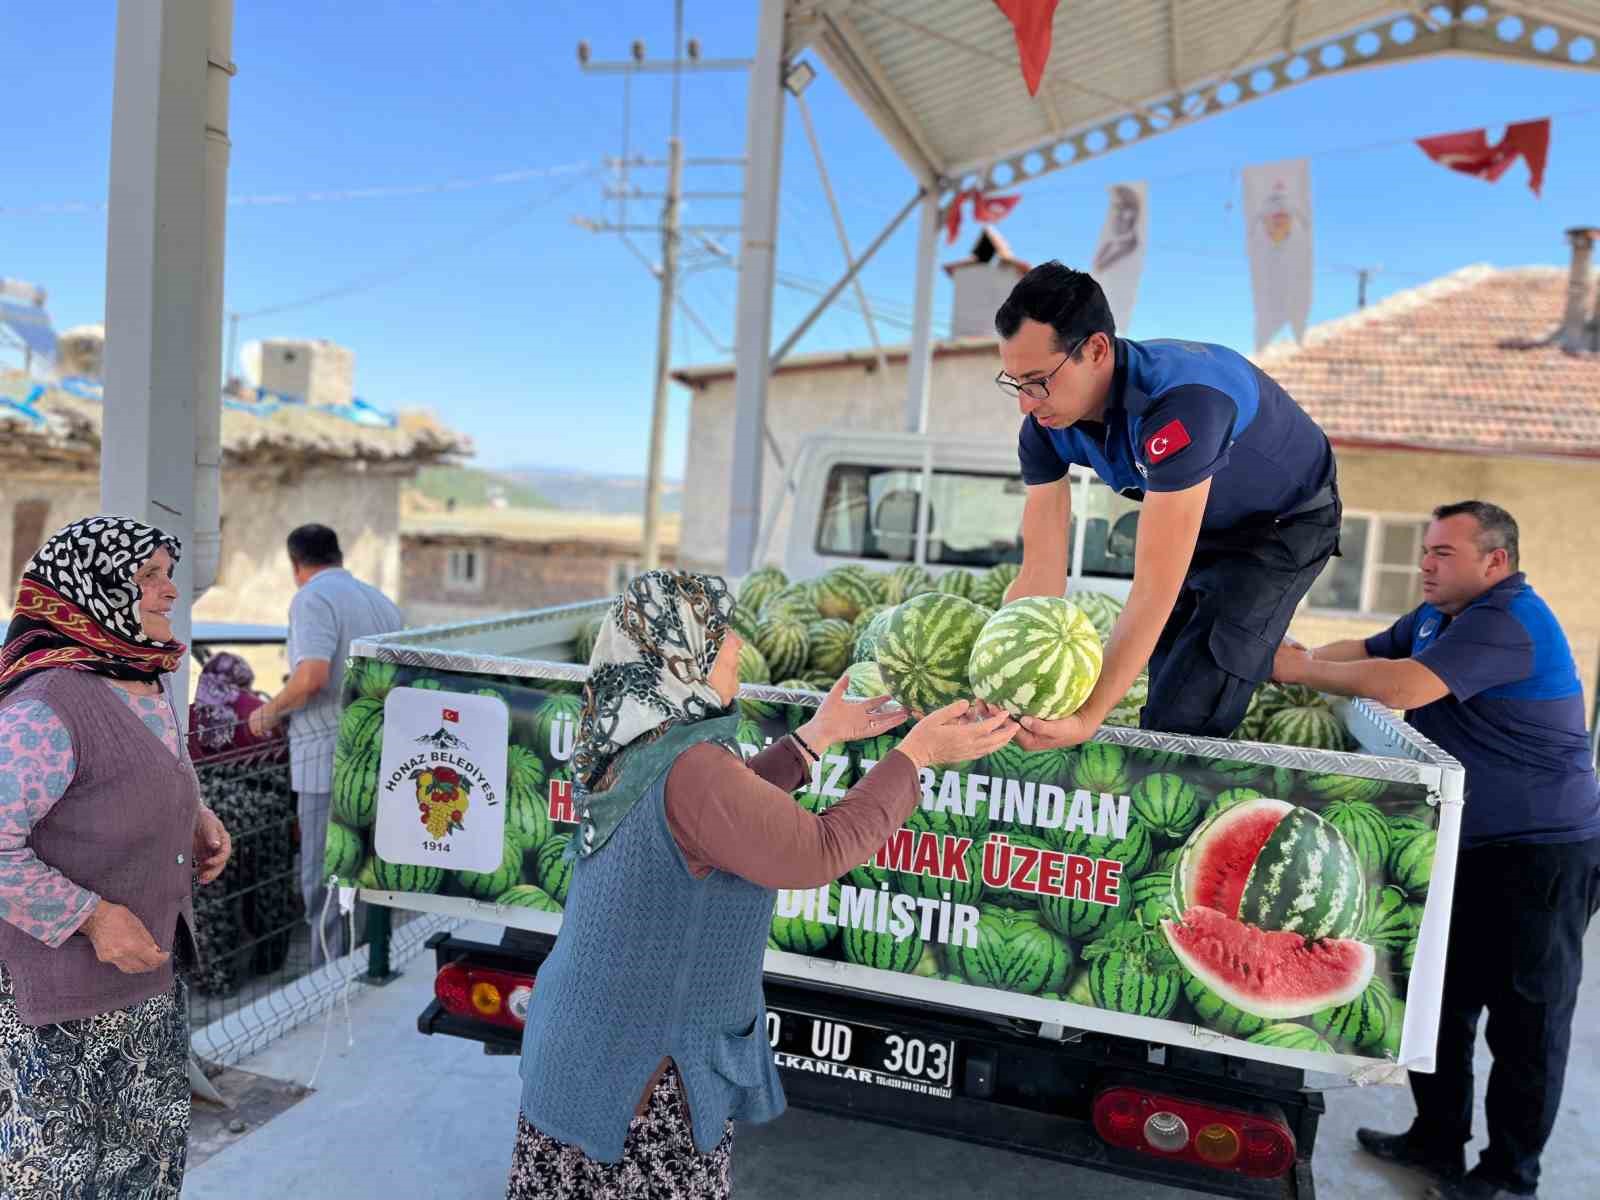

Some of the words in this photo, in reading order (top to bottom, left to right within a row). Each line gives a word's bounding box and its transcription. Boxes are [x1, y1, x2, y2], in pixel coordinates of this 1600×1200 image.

[385, 753, 426, 792] HONAZ
[430, 751, 499, 807] BELEDİYESİ
[861, 759, 1131, 840] RAFINDAN
[422, 840, 451, 853] 1914
[861, 828, 972, 882] MAK
[982, 832, 1123, 907] ÜZERE
[766, 1011, 781, 1048] 0
[811, 1020, 852, 1061] UD
[883, 1034, 948, 1080] 303
[774, 1054, 873, 1083] LKANLAR
